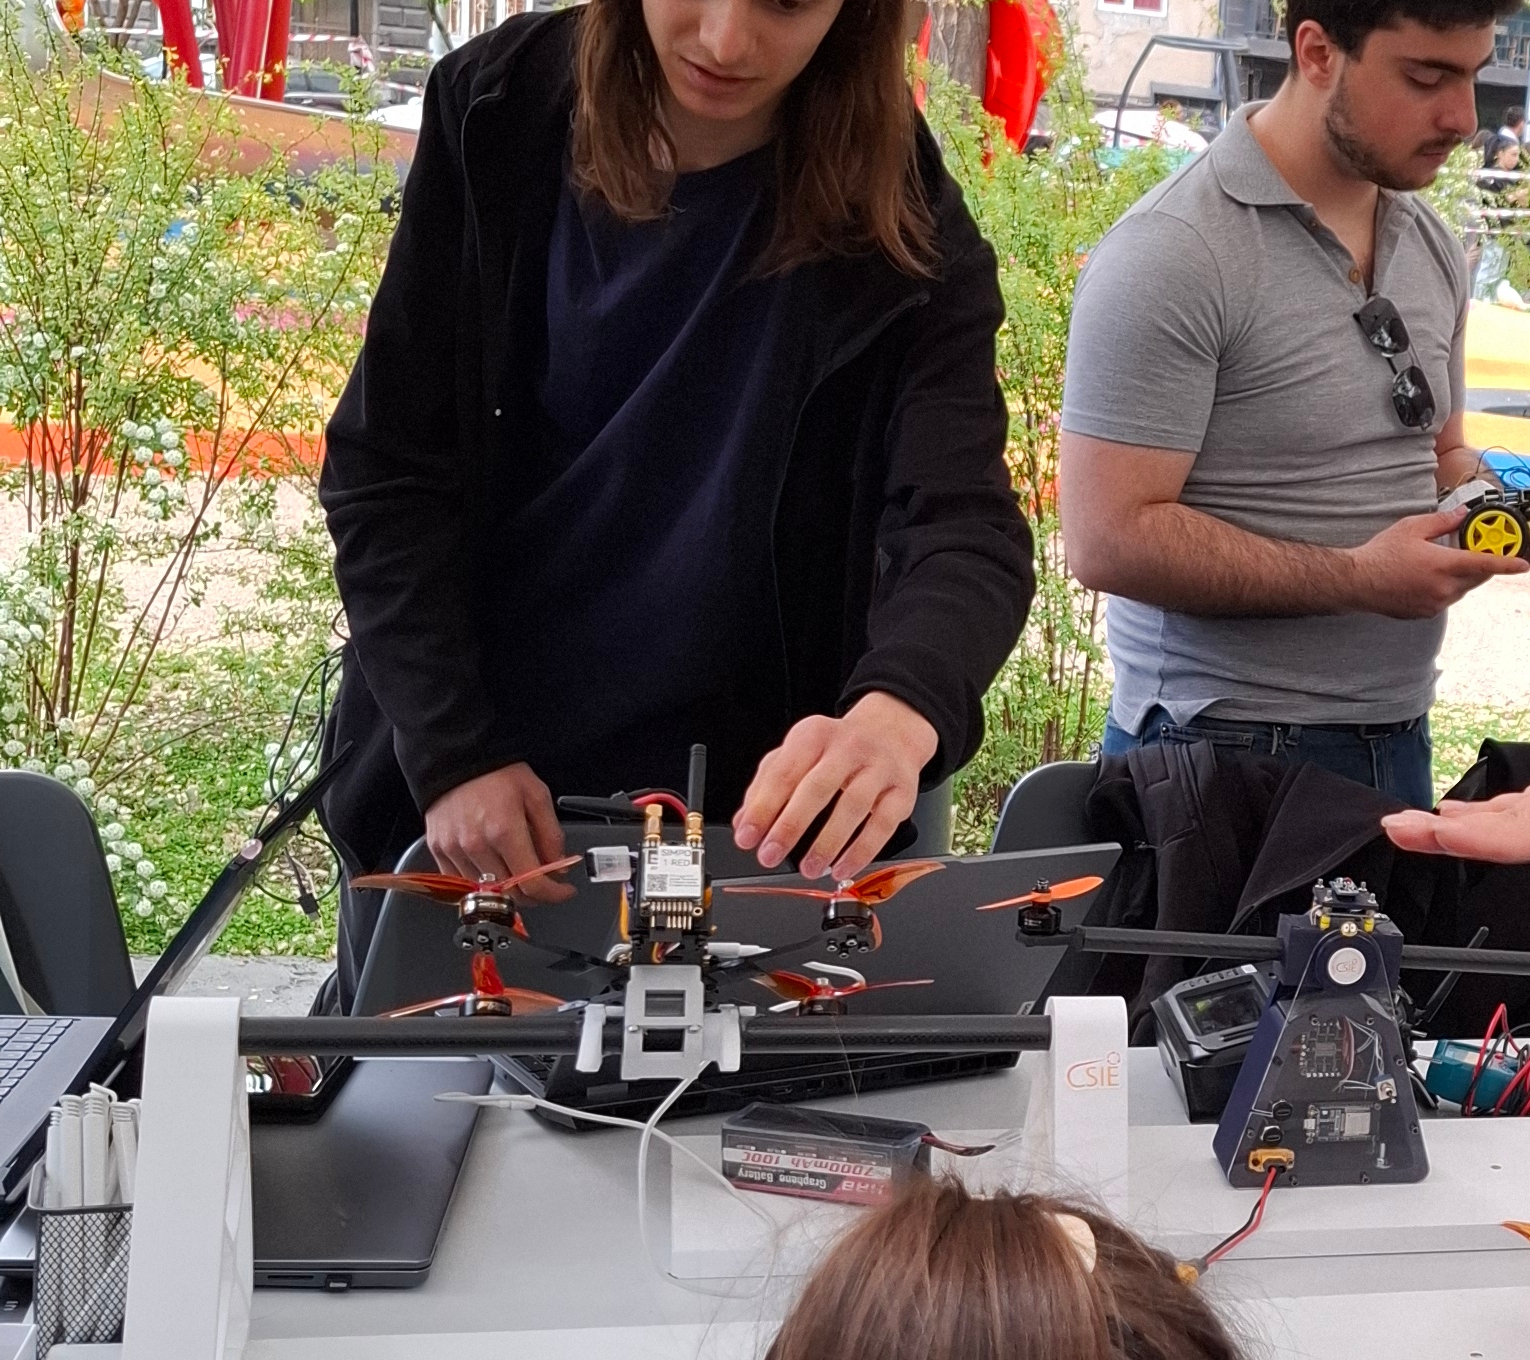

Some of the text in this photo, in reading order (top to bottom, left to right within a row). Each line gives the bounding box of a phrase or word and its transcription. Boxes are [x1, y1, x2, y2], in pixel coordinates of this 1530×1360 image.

[671, 859, 691, 867] RED
[1067, 1052, 1121, 1089] CSIE
[737, 1167, 774, 1183] Battery
[789, 1156, 875, 1177] 7000mAh
[778, 1173, 828, 1190] Graphene
